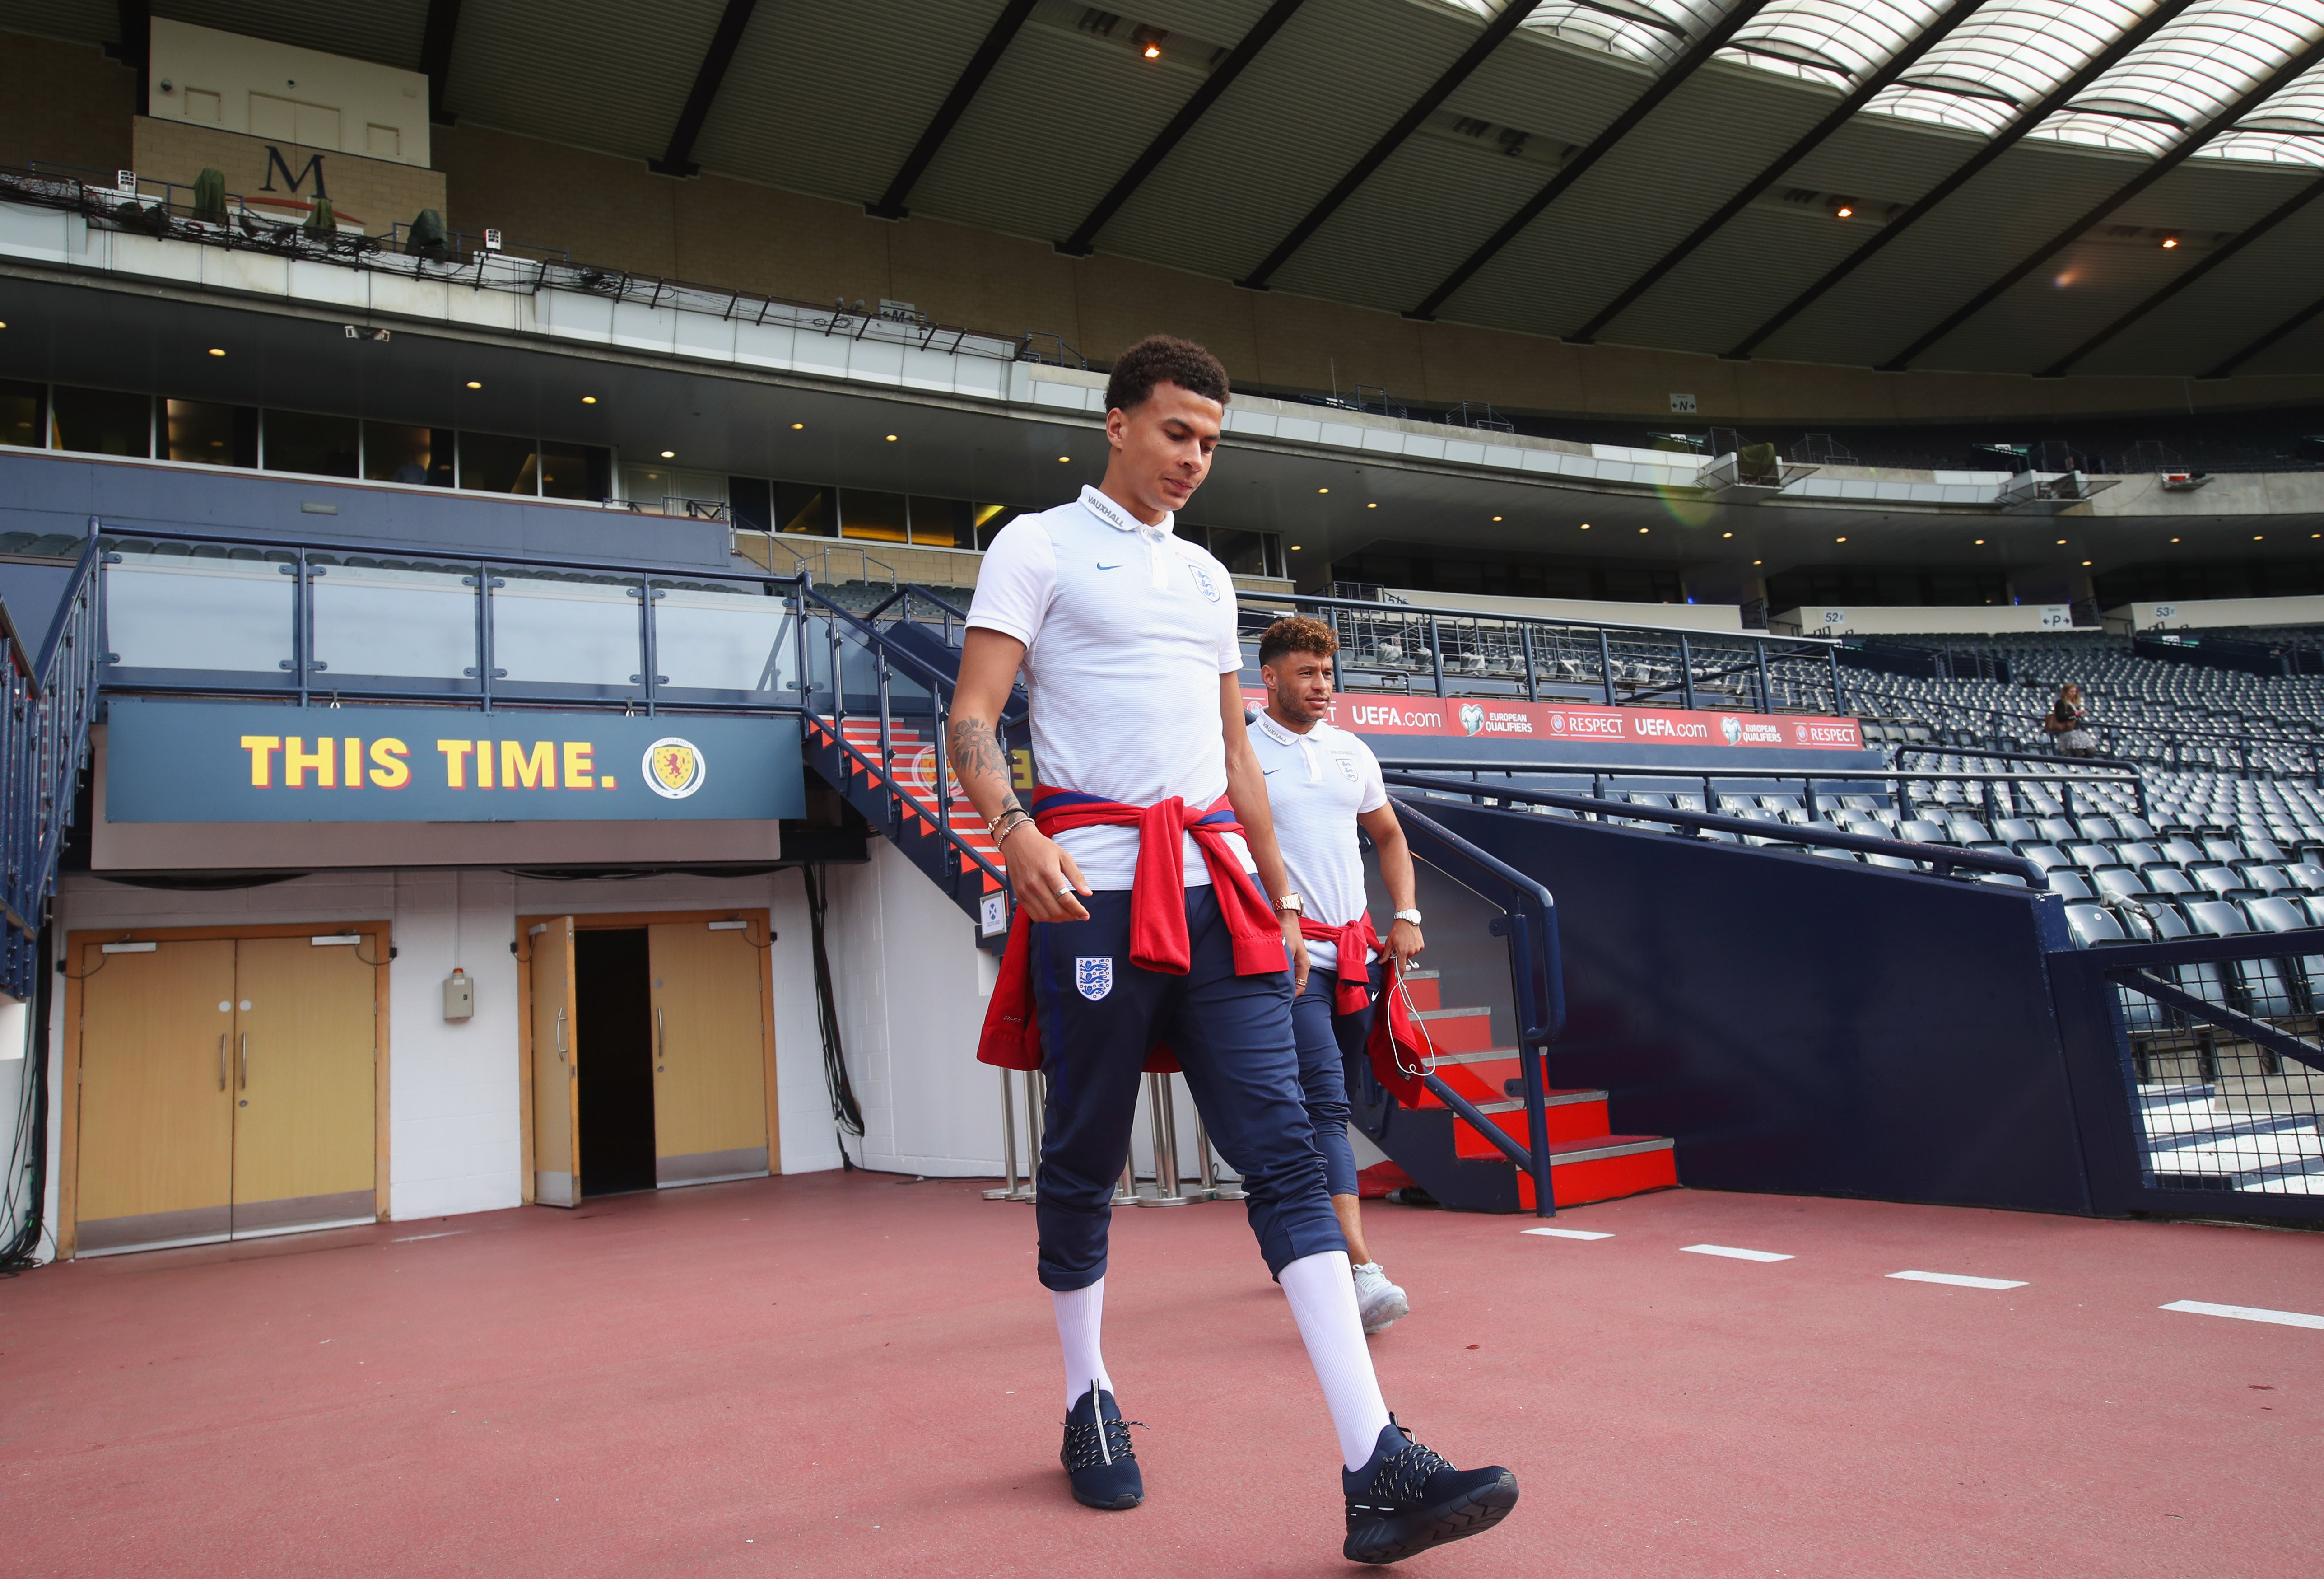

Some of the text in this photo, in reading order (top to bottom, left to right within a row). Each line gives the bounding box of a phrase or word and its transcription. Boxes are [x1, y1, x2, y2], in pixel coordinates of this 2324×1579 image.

[259, 146, 331, 202] M
[892, 310, 905, 322] M
[1679, 401, 1688, 411] N
[1088, 495, 1124, 528] VAUXHALL
[1825, 612, 1838, 622] 52
[2156, 607, 2170, 617] 53
[2052, 615, 2061, 627] P
[1352, 705, 1442, 728] UEFA.com
[1489, 713, 1527, 722] EUROPEAN
[1485, 721, 1533, 733] QUALIFIERS
[1569, 717, 1623, 733] RESPECT
[1635, 718, 1708, 738] UEFA.com
[1745, 724, 1777, 733] EUROPEAN
[1262, 721, 1288, 743] VAUXHALL
[1742, 732, 1782, 743] QUALIFIERS
[1810, 728, 1855, 742] RESPECT
[240, 736, 616, 790] THIS TIME.
[689, 784, 699, 793] 1873
